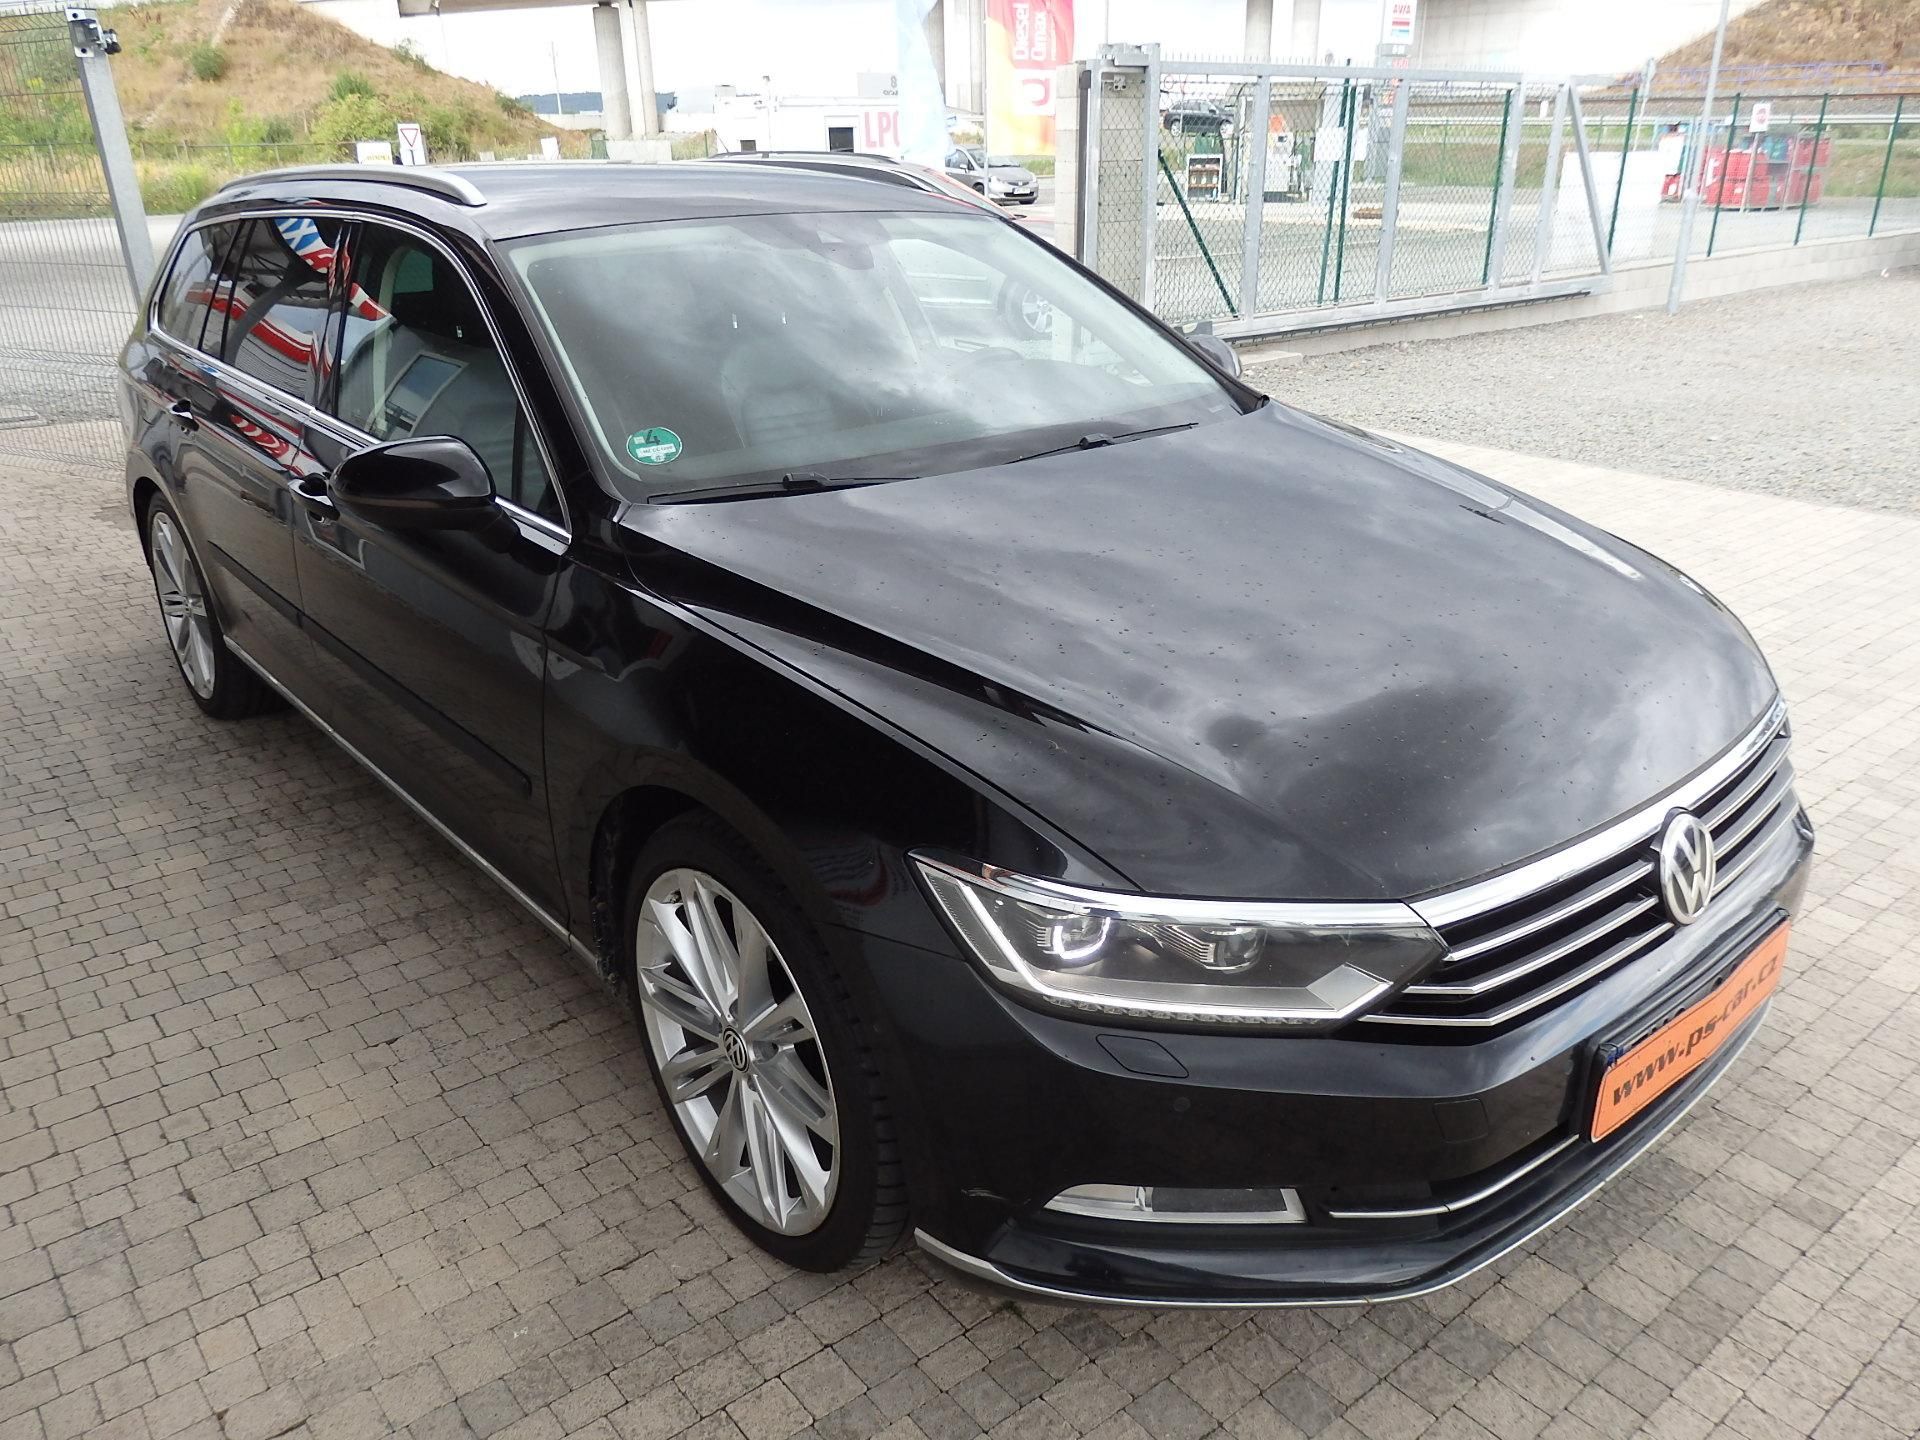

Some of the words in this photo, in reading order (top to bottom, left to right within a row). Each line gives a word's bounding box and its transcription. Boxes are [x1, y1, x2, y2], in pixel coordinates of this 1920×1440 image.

[1013, 3, 1029, 60] Diesel
[645, 429, 661, 445] 4
[1613, 956, 1778, 1106] www.ps-car.cz
